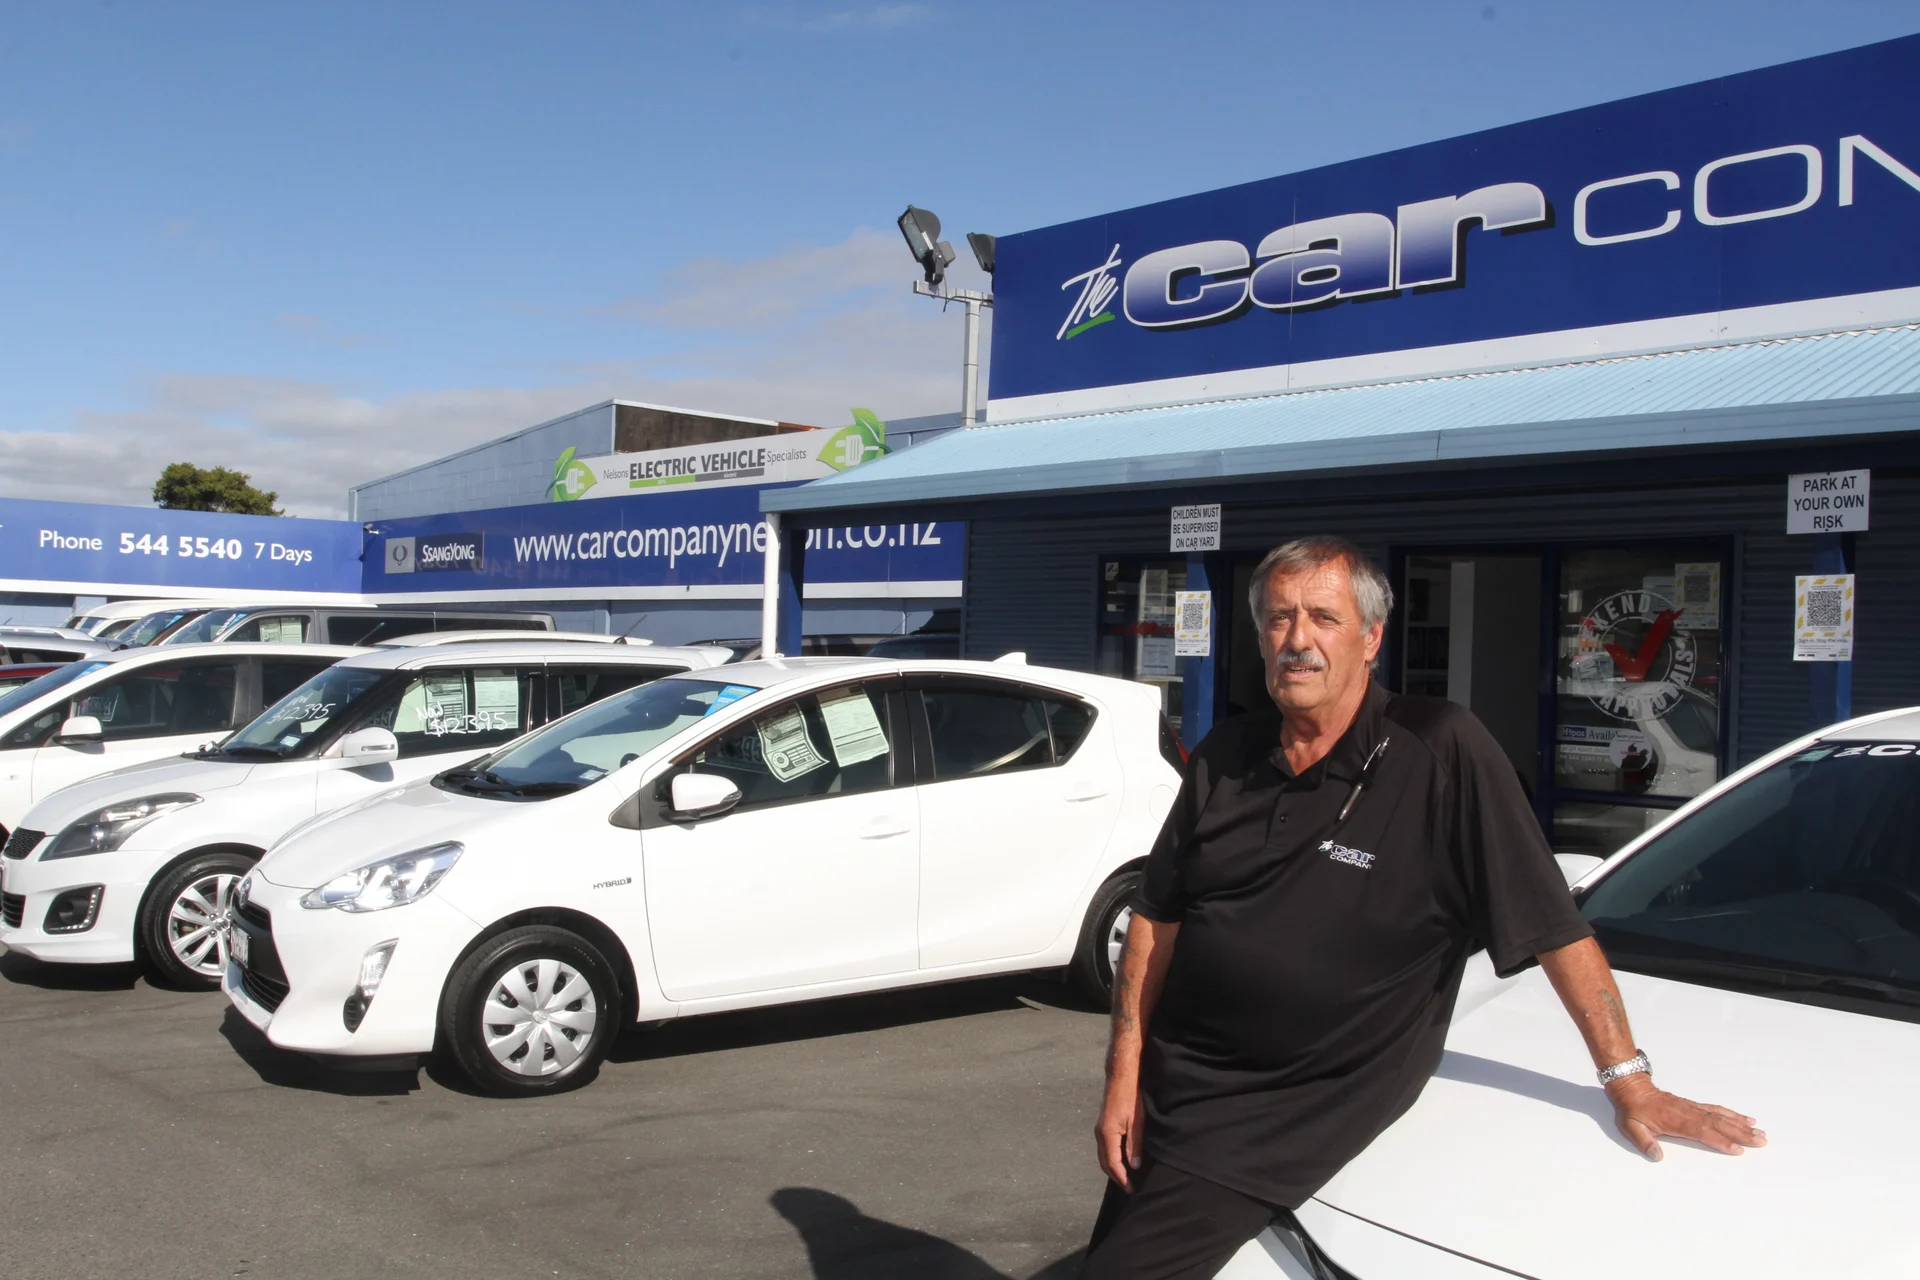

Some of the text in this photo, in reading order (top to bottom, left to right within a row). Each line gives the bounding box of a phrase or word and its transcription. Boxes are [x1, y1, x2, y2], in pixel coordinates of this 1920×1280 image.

[1056, 243, 1120, 341] The
[1123, 181, 1547, 328] car
[603, 447, 807, 480] Nelsons ELECTRIC VEHICLE Specialists
[1802, 475, 1857, 493] PARK AT
[1794, 494, 1865, 512] YOUR OWN
[1172, 505, 1220, 521] CHILDREN MUST
[1812, 514, 1844, 530] RISK
[1172, 521, 1219, 535] BE SUPERVISED
[39, 530, 313, 567] Phone 544 5540 7 Days
[513, 521, 942, 569] www.carcompanynen.co.nz
[1175, 535, 1215, 548] ON CAR YARD
[430, 710, 508, 738] $12395
[593, 879, 626, 890] HYBRID
